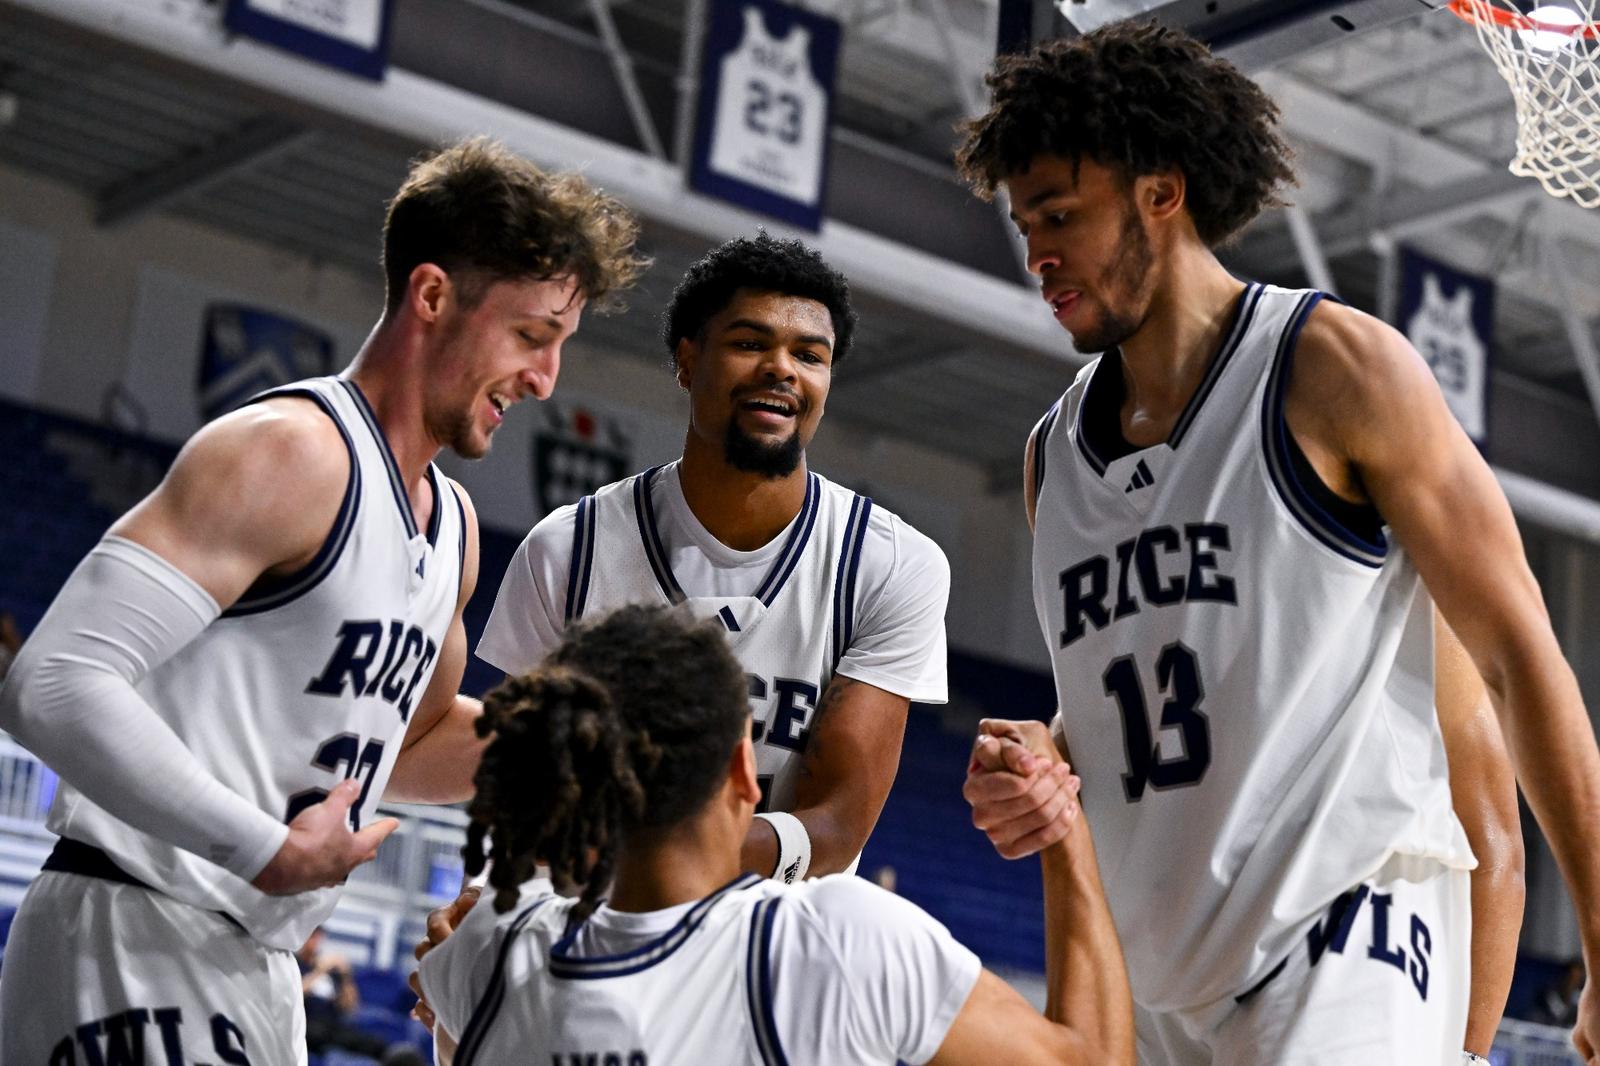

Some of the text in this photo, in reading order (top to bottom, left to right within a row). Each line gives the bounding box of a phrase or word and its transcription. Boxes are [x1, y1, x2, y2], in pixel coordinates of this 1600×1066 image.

[745, 79, 803, 146] 23
[1058, 521, 1239, 650] RICE
[303, 618, 438, 725] RICE
[1101, 638, 1212, 804] 13
[1306, 881, 1432, 1003] WLS
